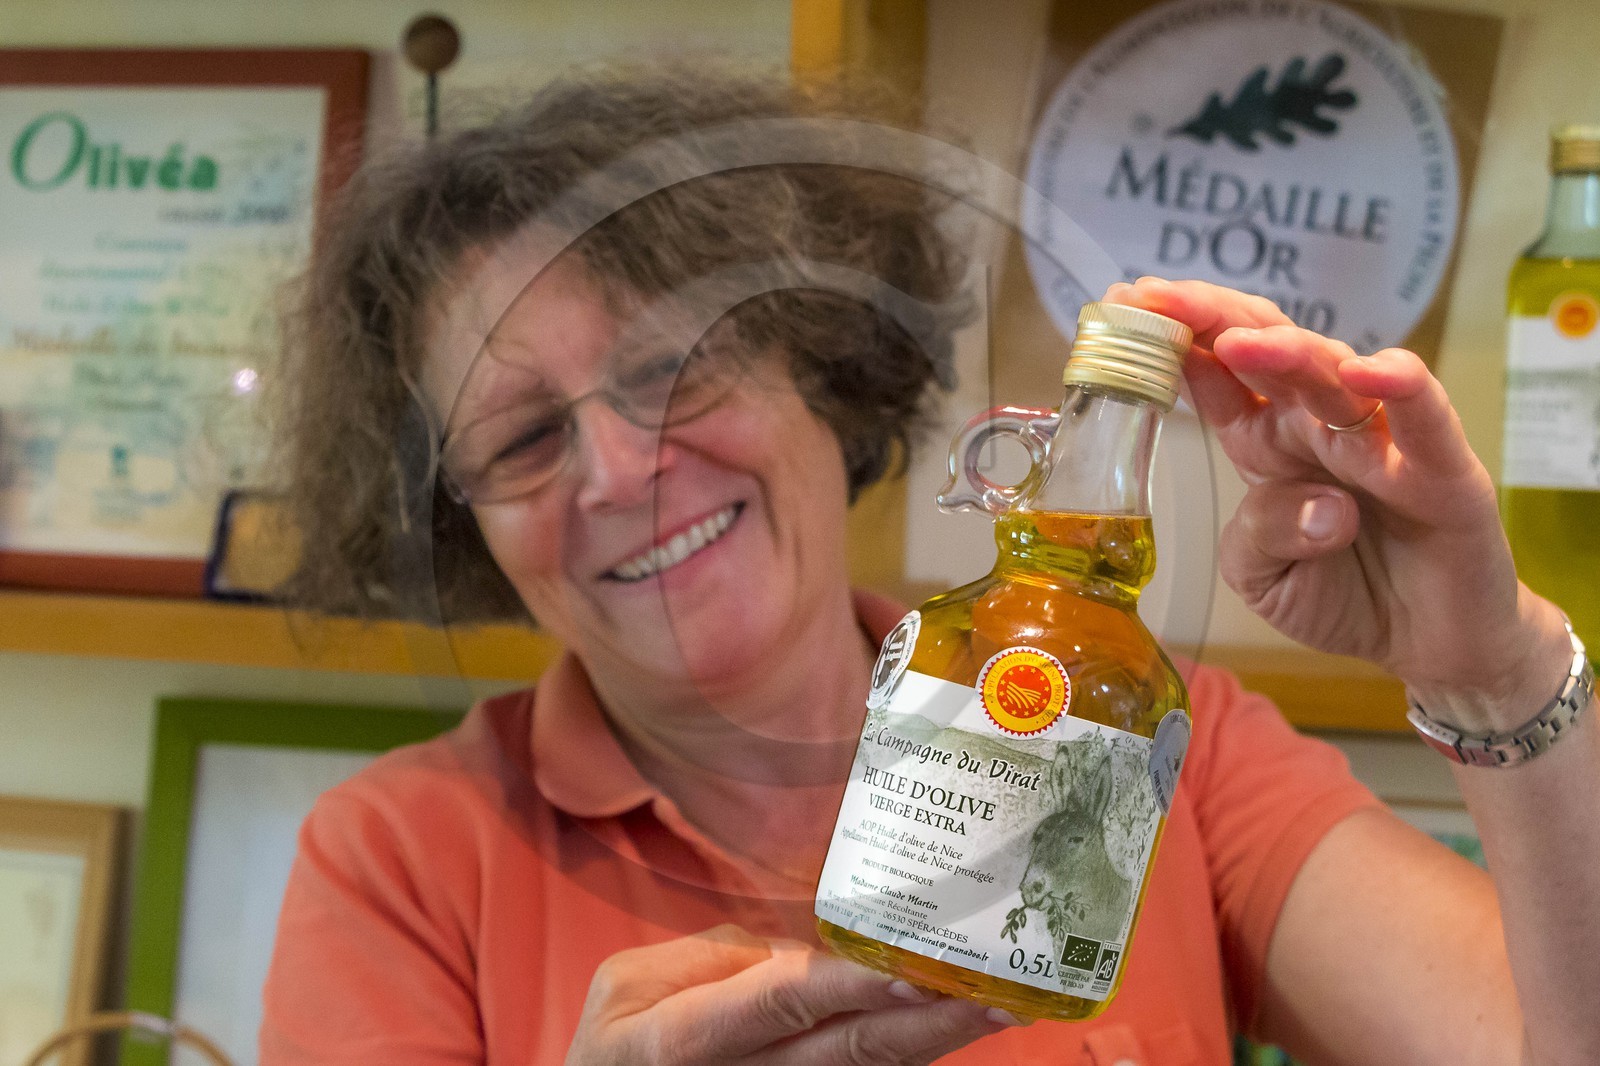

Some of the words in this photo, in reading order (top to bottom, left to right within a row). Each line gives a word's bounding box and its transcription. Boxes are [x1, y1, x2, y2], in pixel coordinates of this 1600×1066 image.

[11, 110, 219, 192] Olivéa
[1105, 146, 1391, 243] MÉDAILLE
[1156, 220, 1303, 286] D'OR
[877, 727, 953, 765] Campagne
[958, 751, 981, 774] du
[989, 759, 1042, 791] Virat
[862, 765, 907, 795] HUILE
[909, 780, 997, 821] D'OLIVE
[869, 793, 912, 819] VIERGE
[914, 808, 966, 836] EXTRA
[859, 819, 877, 833] AOP
[877, 825, 897, 840] Huile
[898, 831, 926, 849] d'olive
[927, 840, 938, 853] de
[939, 844, 963, 860] Nice
[868, 836, 889, 852] Huile
[889, 843, 916, 860] d'olive
[917, 852, 928, 864] de
[930, 855, 953, 872] Nice
[953, 863, 995, 885] protégée
[850, 874, 879, 890] Madame
[879, 886, 906, 901] Claude
[907, 894, 938, 911] Martin
[861, 857, 889, 872] PRODUIT
[888, 866, 935, 887] BIOLOGIQUE
[882, 910, 906, 924] 06530
[907, 917, 969, 944] SPÉRACÈDES
[887, 900, 928, 920] Récoltante
[1009, 948, 1054, 979] 0,5L
